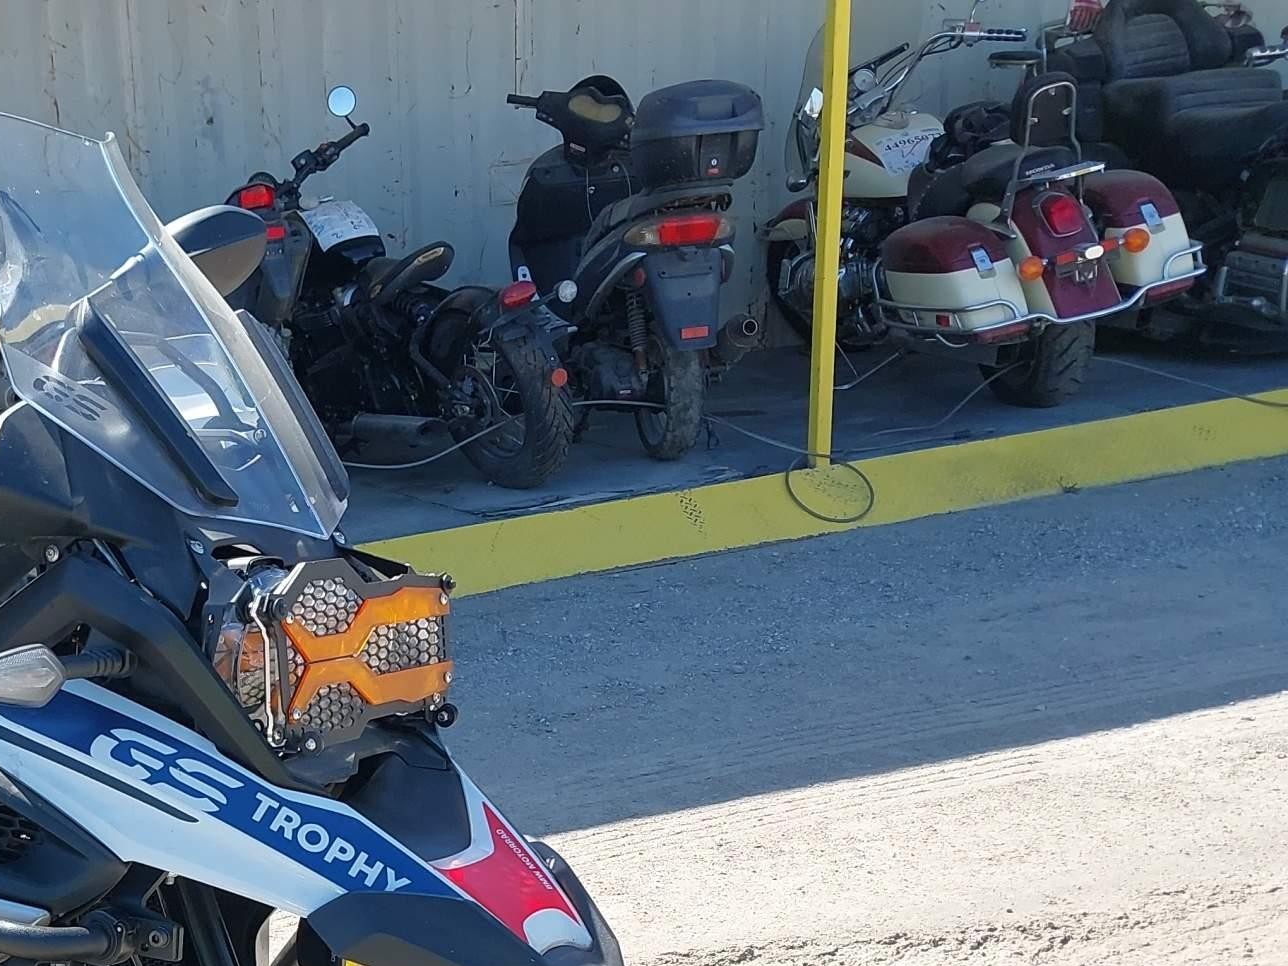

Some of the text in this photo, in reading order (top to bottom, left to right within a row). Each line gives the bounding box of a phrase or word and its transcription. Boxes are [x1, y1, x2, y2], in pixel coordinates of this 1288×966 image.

[1025, 163, 1055, 176] HONDA
[90, 728, 412, 892] GS TROPHY
[495, 828, 553, 890] BMW MOTORRAD
